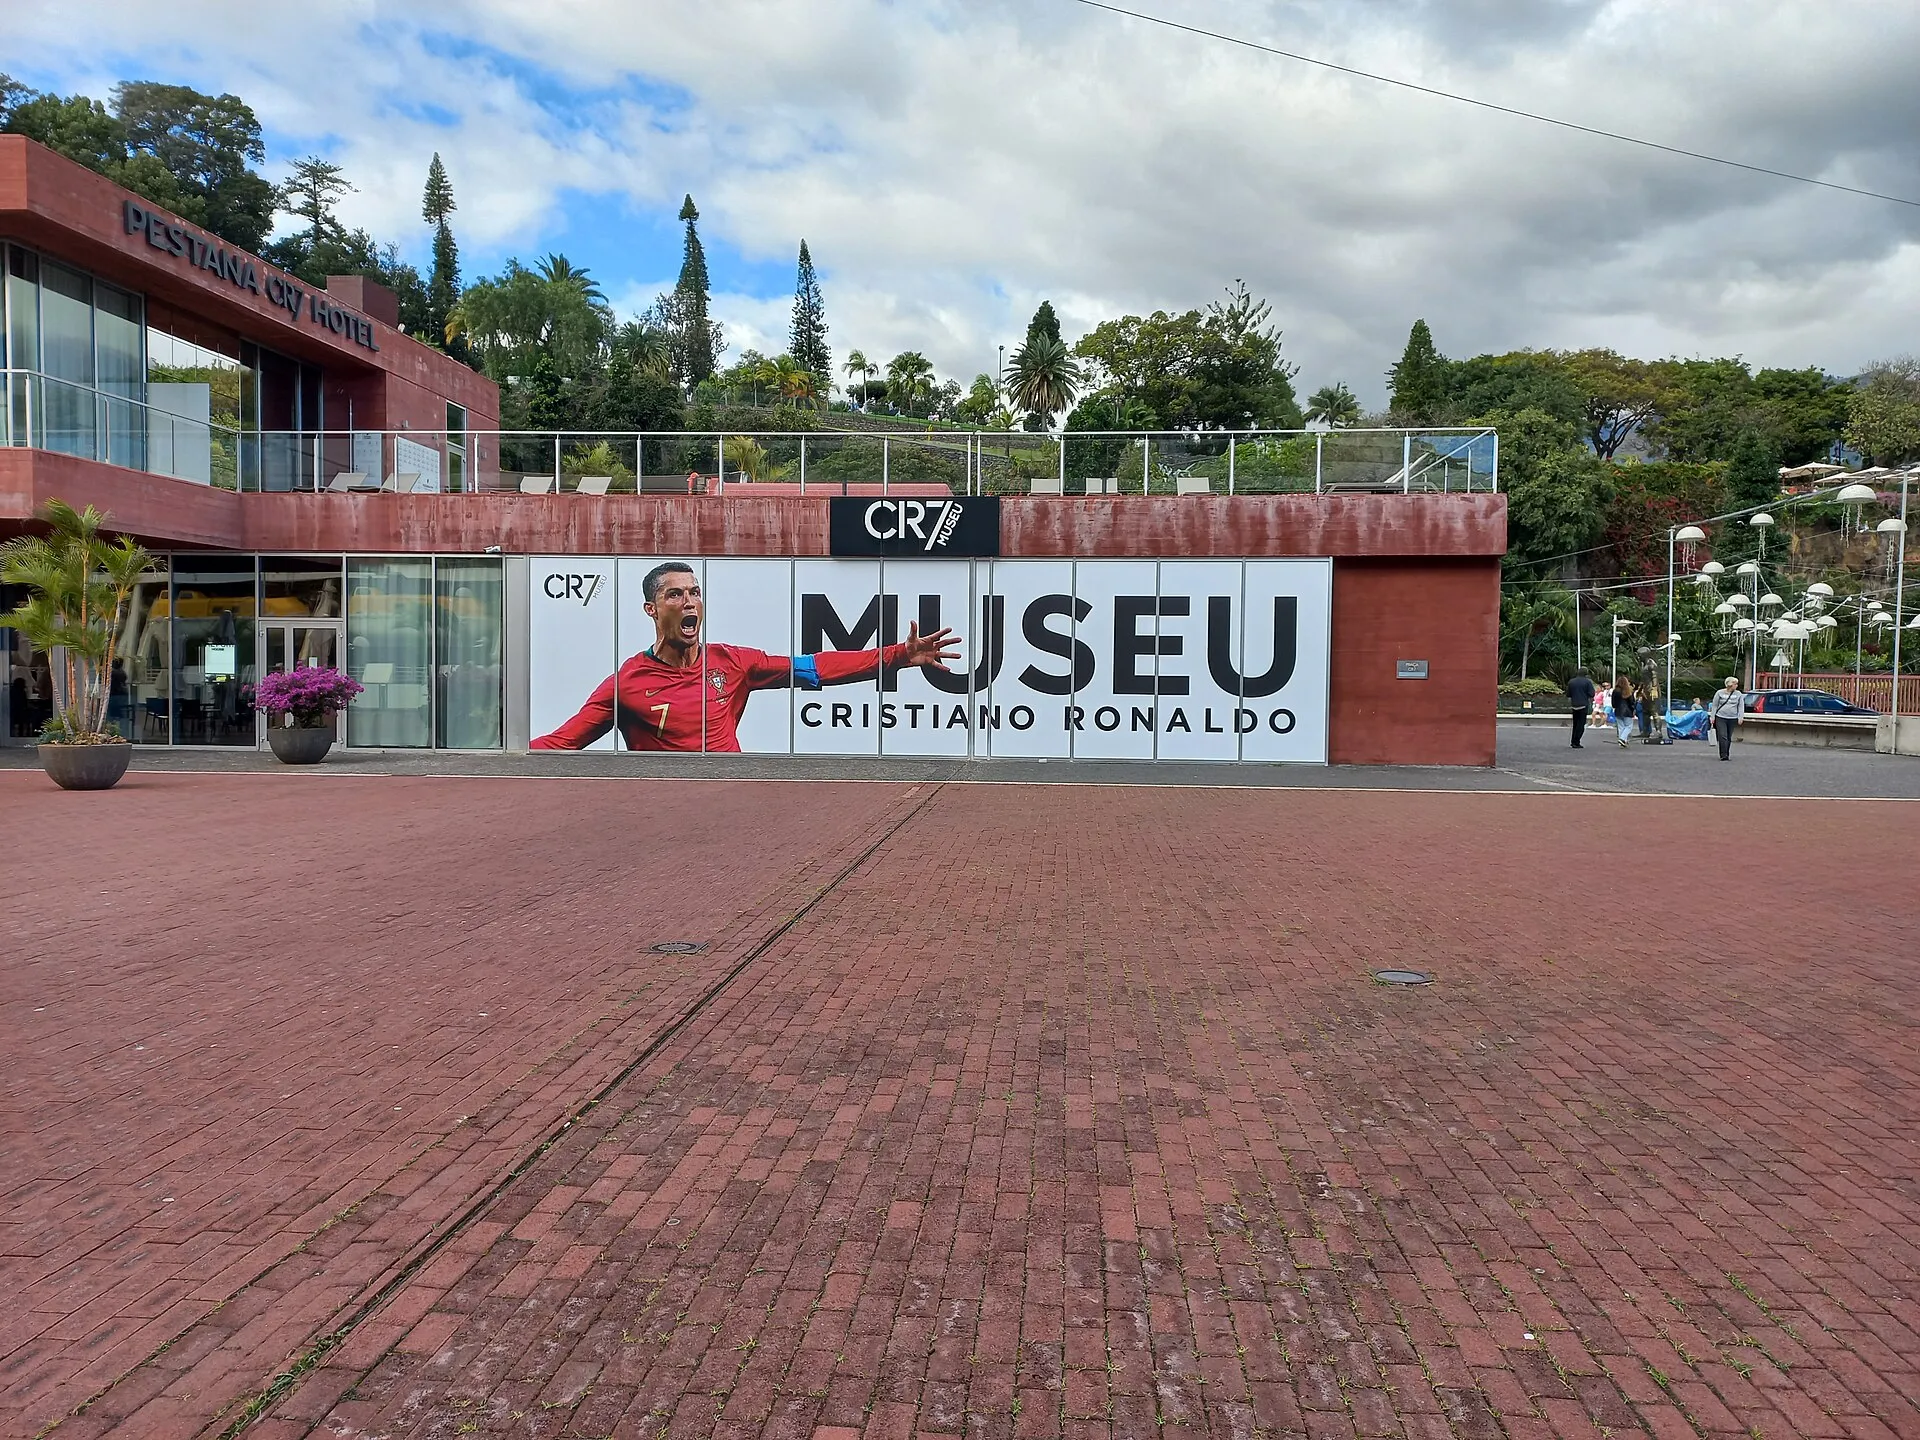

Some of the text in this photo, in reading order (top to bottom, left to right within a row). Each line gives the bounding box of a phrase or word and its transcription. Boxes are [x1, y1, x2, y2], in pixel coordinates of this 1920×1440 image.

[124, 200, 380, 352] PESTANA CR7 HOTEL
[864, 500, 954, 551] CR7
[936, 502, 964, 547] MUSEU
[543, 573, 601, 607] CR7
[593, 575, 607, 599] MUSEU
[800, 593, 1298, 698] MUSEU
[651, 703, 670, 739] 7
[800, 702, 1297, 734] CRISTIANO RONALDO
